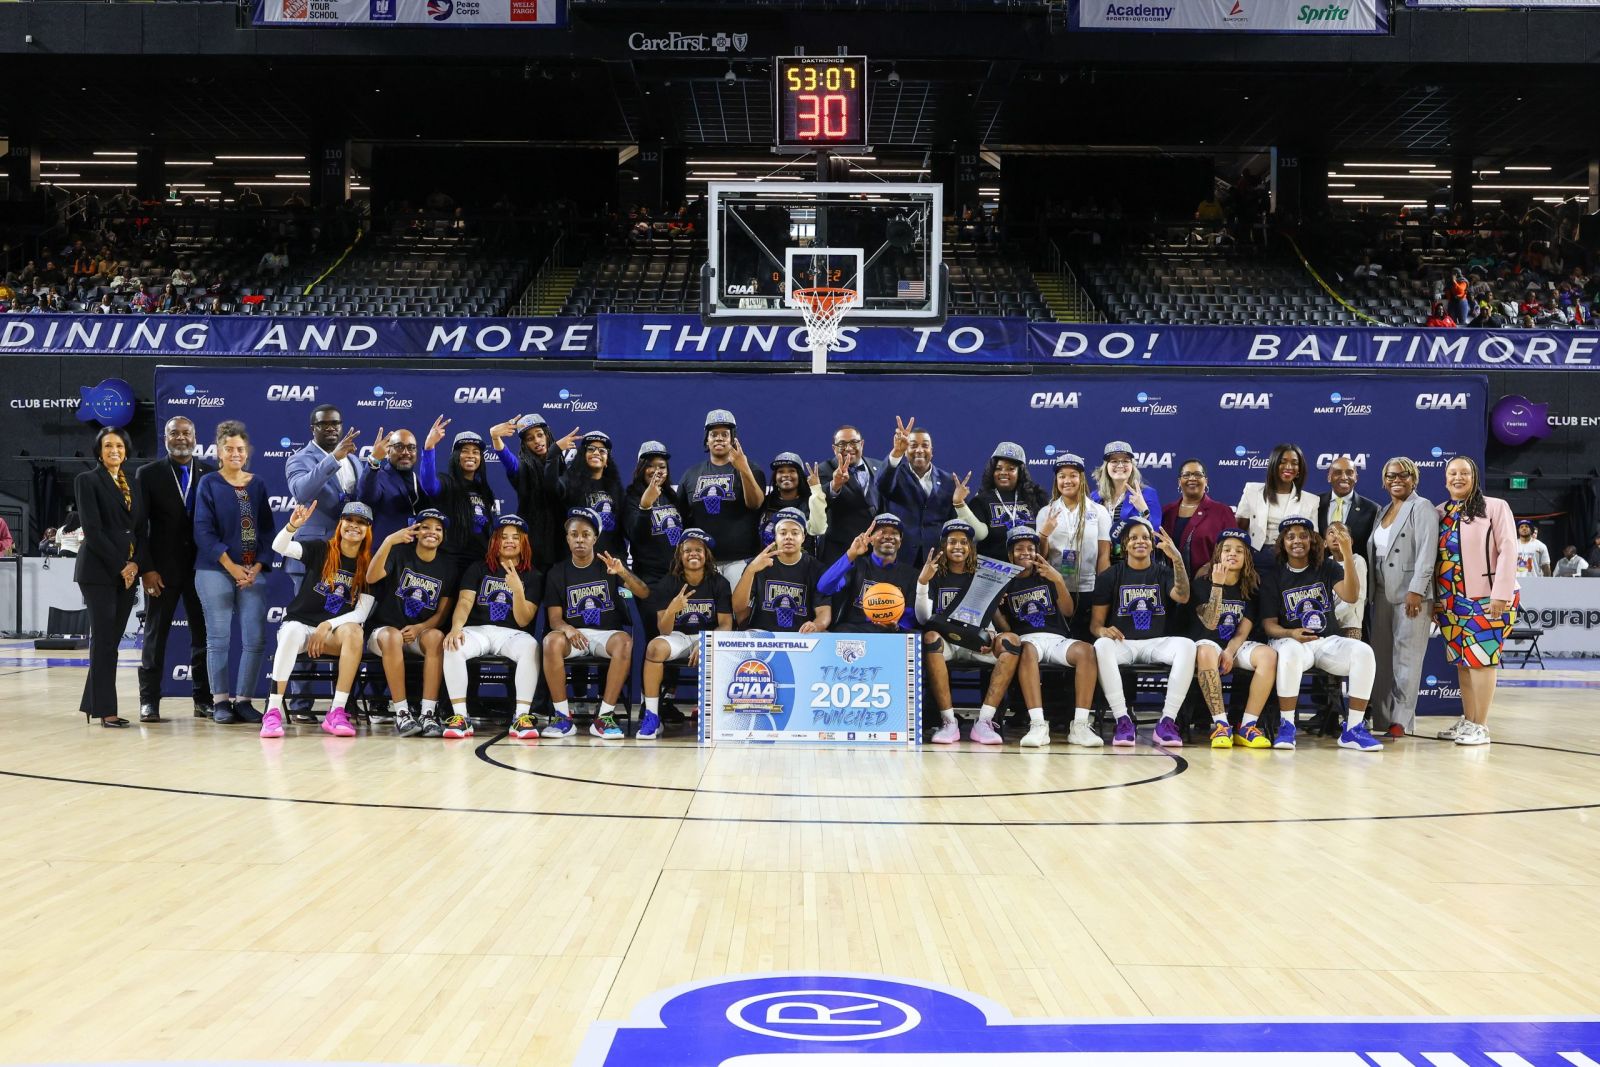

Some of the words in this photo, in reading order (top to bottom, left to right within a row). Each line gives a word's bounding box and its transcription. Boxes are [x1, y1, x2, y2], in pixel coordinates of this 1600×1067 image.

[309, 11, 339, 19] SCHOOL
[1106, 3, 1173, 20] Academy
[1297, 4, 1349, 24] Sprite
[628, 32, 706, 51] CareFirst
[787, 67, 856, 91] 53:07
[798, 95, 847, 137] 30
[325, 149, 342, 159] 110
[641, 152, 658, 161] 112
[959, 154, 977, 165] 113
[1280, 158, 1298, 168] 115
[727, 284, 755, 295] CIAA
[0, 320, 209, 350] DINING
[254, 323, 378, 350] AND
[426, 324, 593, 352] MORE
[912, 326, 985, 354] TO
[1052, 331, 1160, 359] DO!
[1247, 333, 1600, 364] BALTIMORE
[266, 385, 315, 401] CIAA
[454, 387, 502, 404] CIAA
[10, 399, 41, 409] CLUB
[43, 398, 81, 408] ENTRY
[196, 394, 225, 408] YOURS
[384, 396, 413, 410] YOURS
[570, 399, 598, 412] YOURS
[1030, 392, 1079, 409] CIAA
[1219, 393, 1270, 410] CIAA
[1415, 393, 1467, 410] CIAA
[1149, 402, 1177, 415] YOURS
[1342, 402, 1371, 416] YOURS
[1547, 416, 1578, 426] CLUB
[1580, 416, 1600, 426] EN
[1247, 455, 1270, 469] YOUR
[268, 496, 296, 512] CIA
[422, 512, 447, 520] CIAA
[572, 509, 593, 519] CIAA
[500, 518, 523, 526] CIAA
[1282, 518, 1307, 526] CIAA
[1111, 520, 1128, 539] CIAA
[1223, 531, 1247, 539] CIAA
[688, 532, 711, 542] CIAA
[867, 598, 895, 606] Wilson
[1123, 588, 1158, 607] CHAMPS
[872, 611, 894, 619] NCAA
[757, 641, 809, 649] BASKETBALL
[820, 665, 882, 681] TICKET
[728, 683, 776, 699] CIAA
[810, 682, 891, 708] 2025
[1438, 685, 1461, 698] YOUR
[812, 707, 888, 727] PUNCHED
